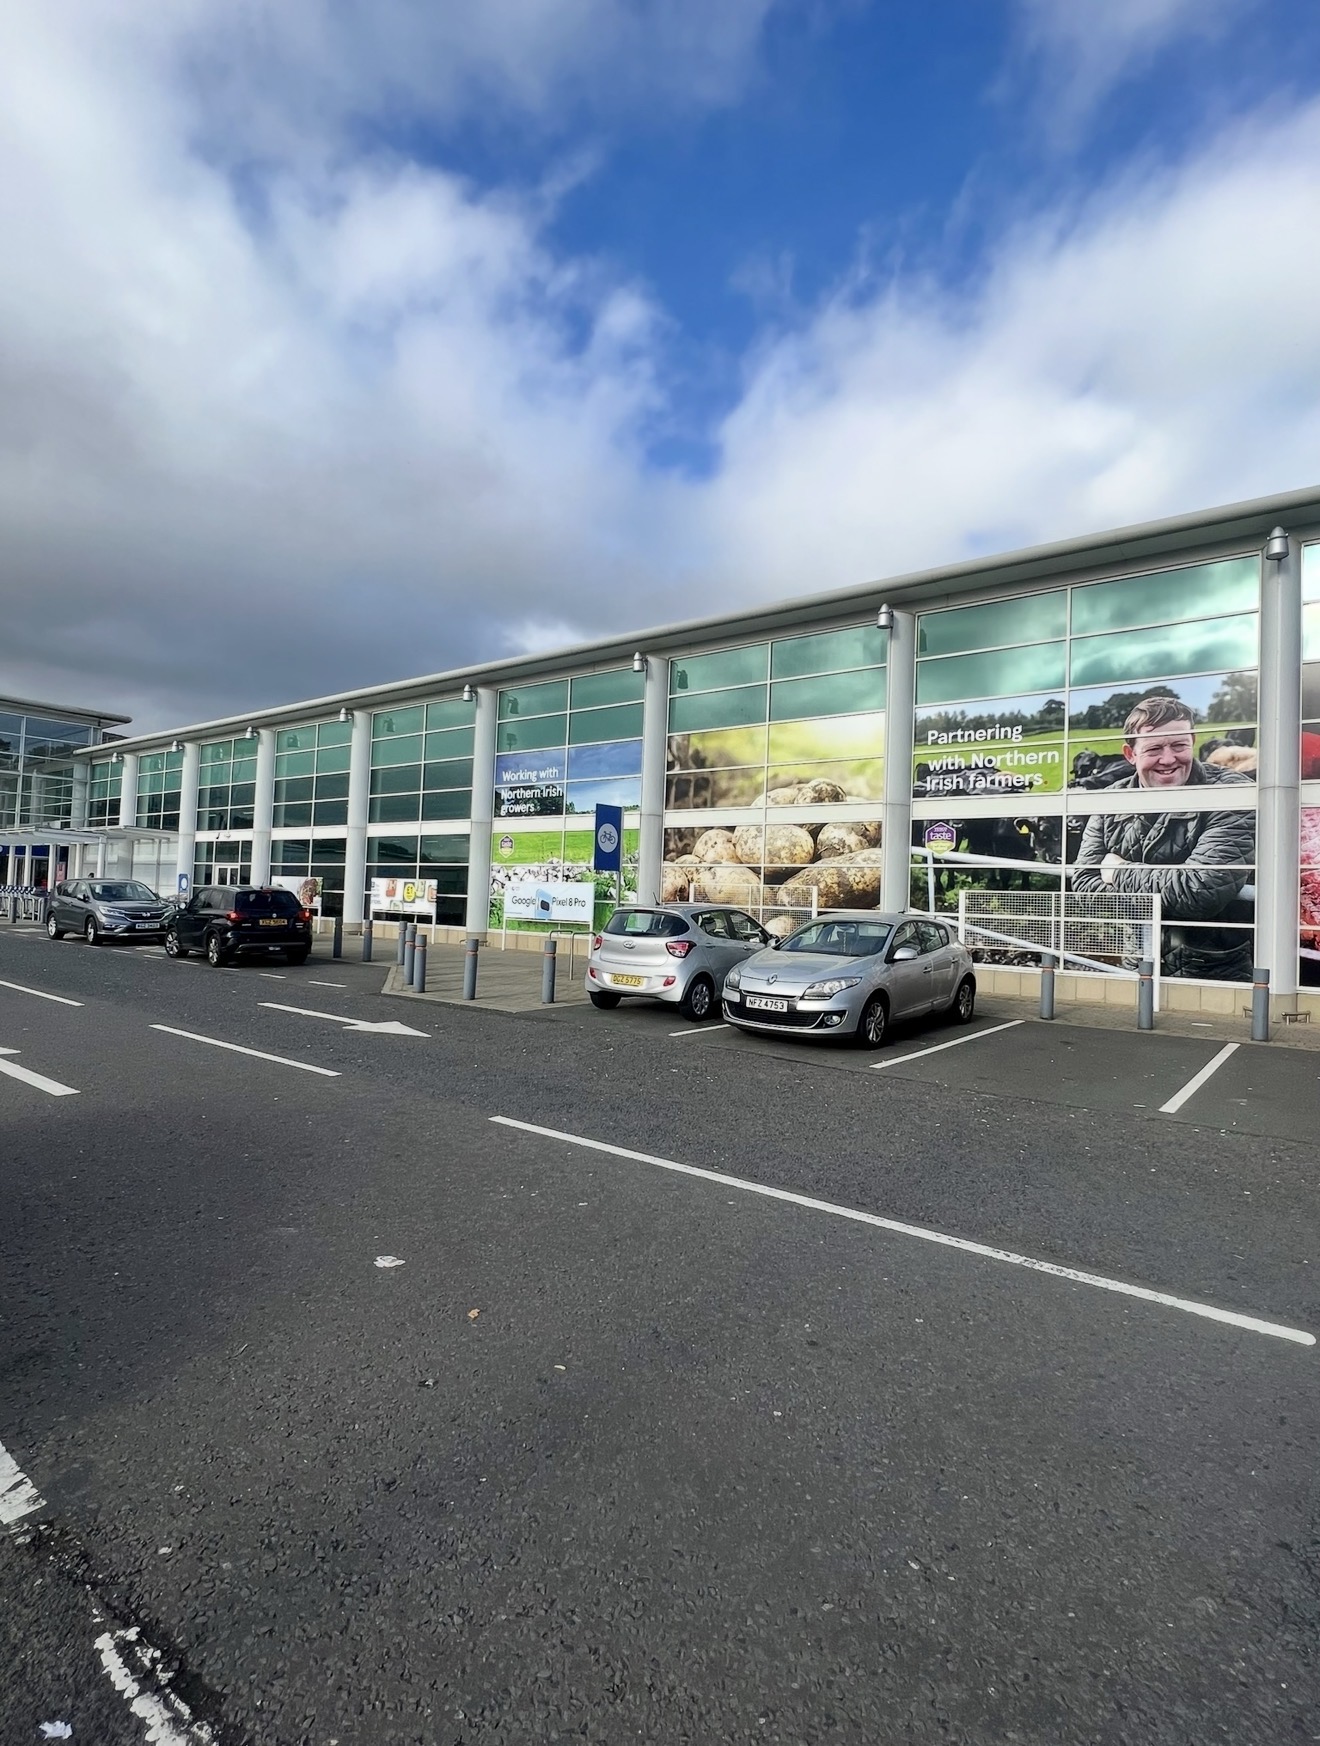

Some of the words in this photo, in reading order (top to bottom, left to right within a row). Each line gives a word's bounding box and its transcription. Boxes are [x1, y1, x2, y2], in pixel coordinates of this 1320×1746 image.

[927, 723, 1023, 746] Partnering
[928, 754, 965, 772] with
[971, 749, 1060, 770] Northern
[502, 769, 538, 783] Working
[539, 766, 559, 780] with
[925, 775, 963, 791] Irish
[968, 771, 1043, 789] farmers
[500, 787, 541, 800] Northern
[542, 785, 563, 797] Irish
[500, 802, 535, 816] growers
[929, 831, 952, 840] taste
[511, 895, 536, 908] Google
[551, 896, 568, 907] Pixel
[568, 897, 573, 907] 8
[574, 897, 587, 908] Pro
[748, 998, 763, 1008] NFZ
[764, 1000, 785, 1010] 4753
